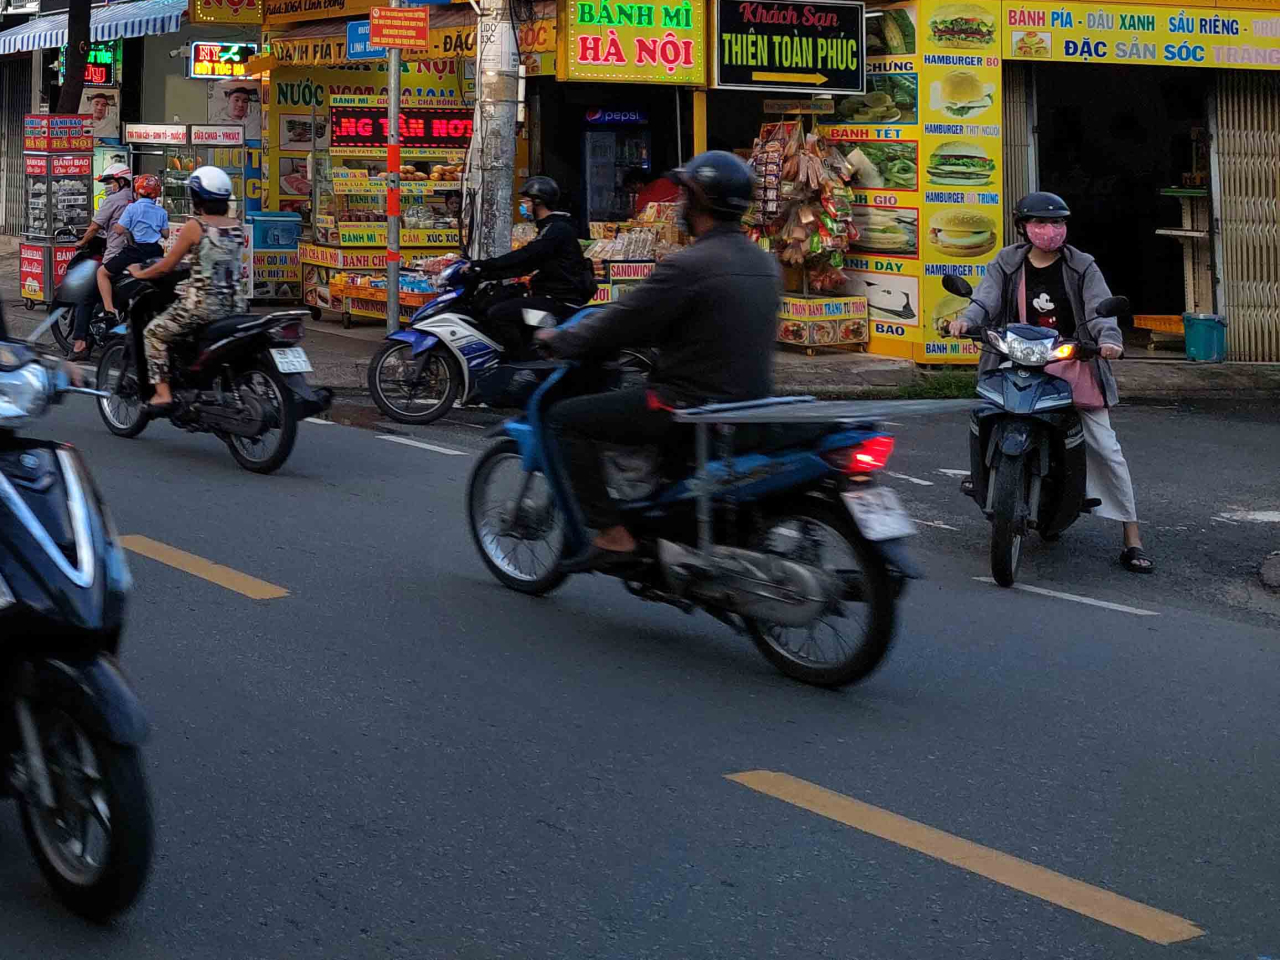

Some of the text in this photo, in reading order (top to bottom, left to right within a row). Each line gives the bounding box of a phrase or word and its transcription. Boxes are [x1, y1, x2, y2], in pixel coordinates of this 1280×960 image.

[660, 0, 693, 30] MÌ
[739, 2, 840, 28] Khách Sạn
[1007, 7, 1239, 36] BÁNH PÍA ĐẬU XANH SẦU RIÊNG
[199, 45, 222, 60] NY
[350, 42, 365, 54] LINH
[577, 31, 695, 73] HÀ NỘI
[722, 27, 858, 72] THIÊN TOÀN PHÚC
[1064, 40, 1108, 62] ĐẶC
[1114, 36, 1156, 60] SẢN
[1163, 40, 1205, 62] SÓC
[924, 54, 983, 67] HAMBURGER
[276, 77, 324, 106] NƯỚC
[605, 110, 639, 122] pepsi
[830, 126, 902, 139] BÁNH TẾT
[924, 123, 963, 135] HAMBURGER
[53, 157, 89, 166] BÁNH BAO
[874, 193, 898, 206] GIÒ
[925, 191, 965, 203] HAMBURGER
[341, 230, 365, 243] BÁNH
[366, 229, 377, 243] MÌ
[426, 230, 443, 244] XÚC
[342, 253, 369, 267] BÁNH
[610, 264, 653, 278] SANDWICH
[925, 263, 972, 277] HAMBURGER
[875, 323, 906, 336] BAO
[925, 342, 948, 354] BÁNH
[949, 342, 960, 354] MÌ
